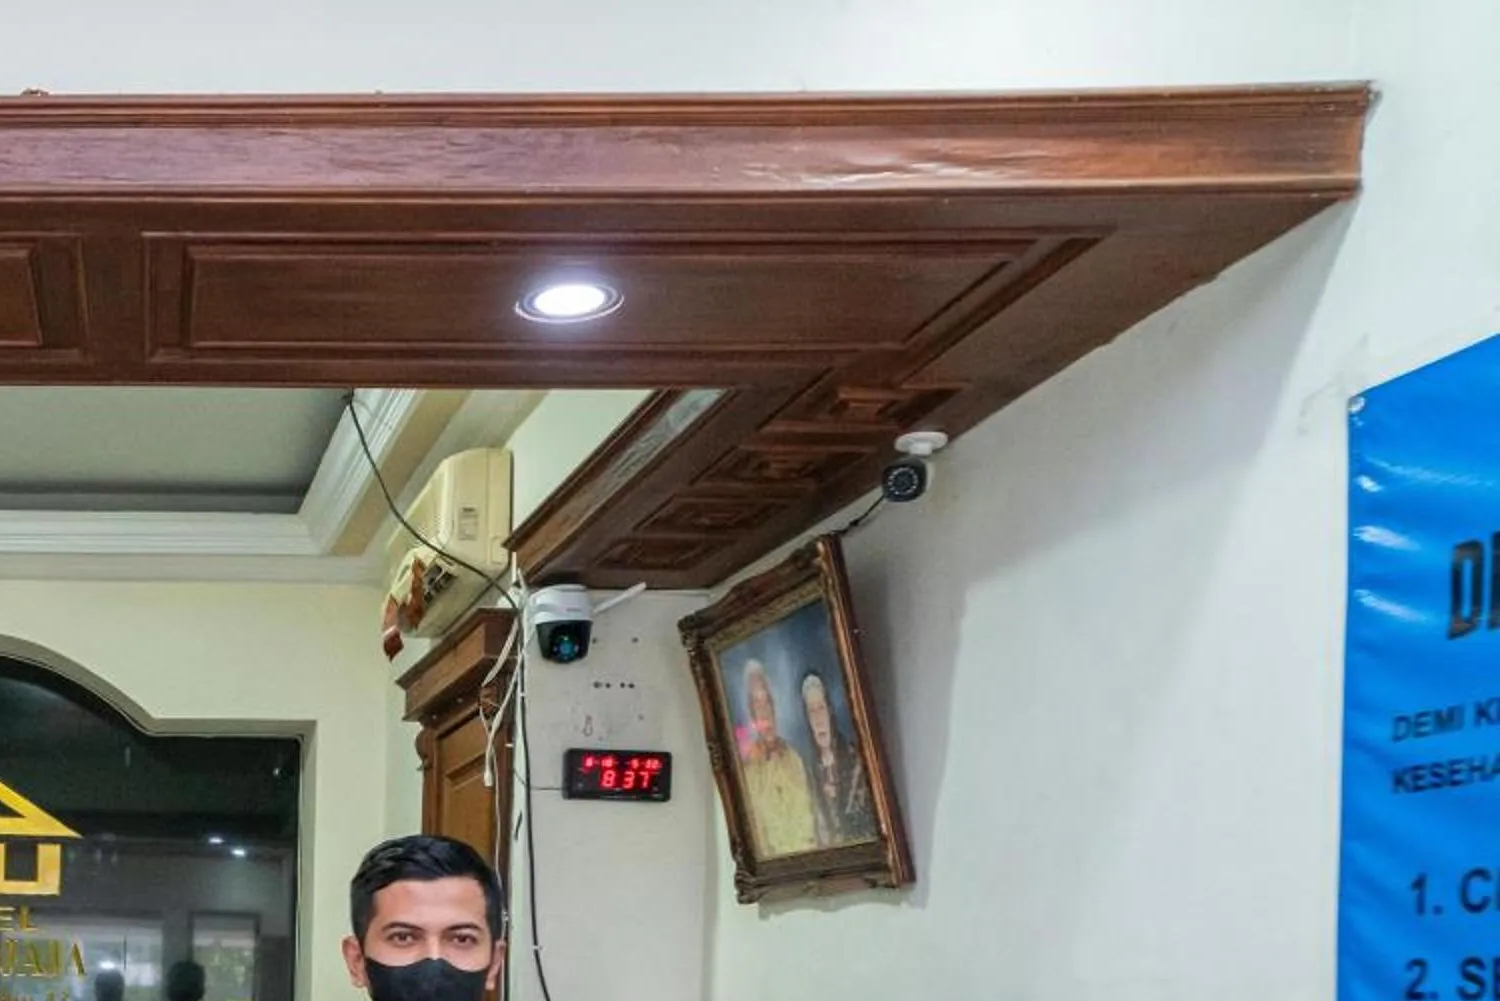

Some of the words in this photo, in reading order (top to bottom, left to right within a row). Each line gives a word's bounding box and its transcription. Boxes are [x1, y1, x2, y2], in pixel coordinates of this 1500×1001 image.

[1393, 705, 1464, 742] DEMI
[1411, 873, 1443, 916] 1.
[1405, 958, 1439, 1001] 2.
